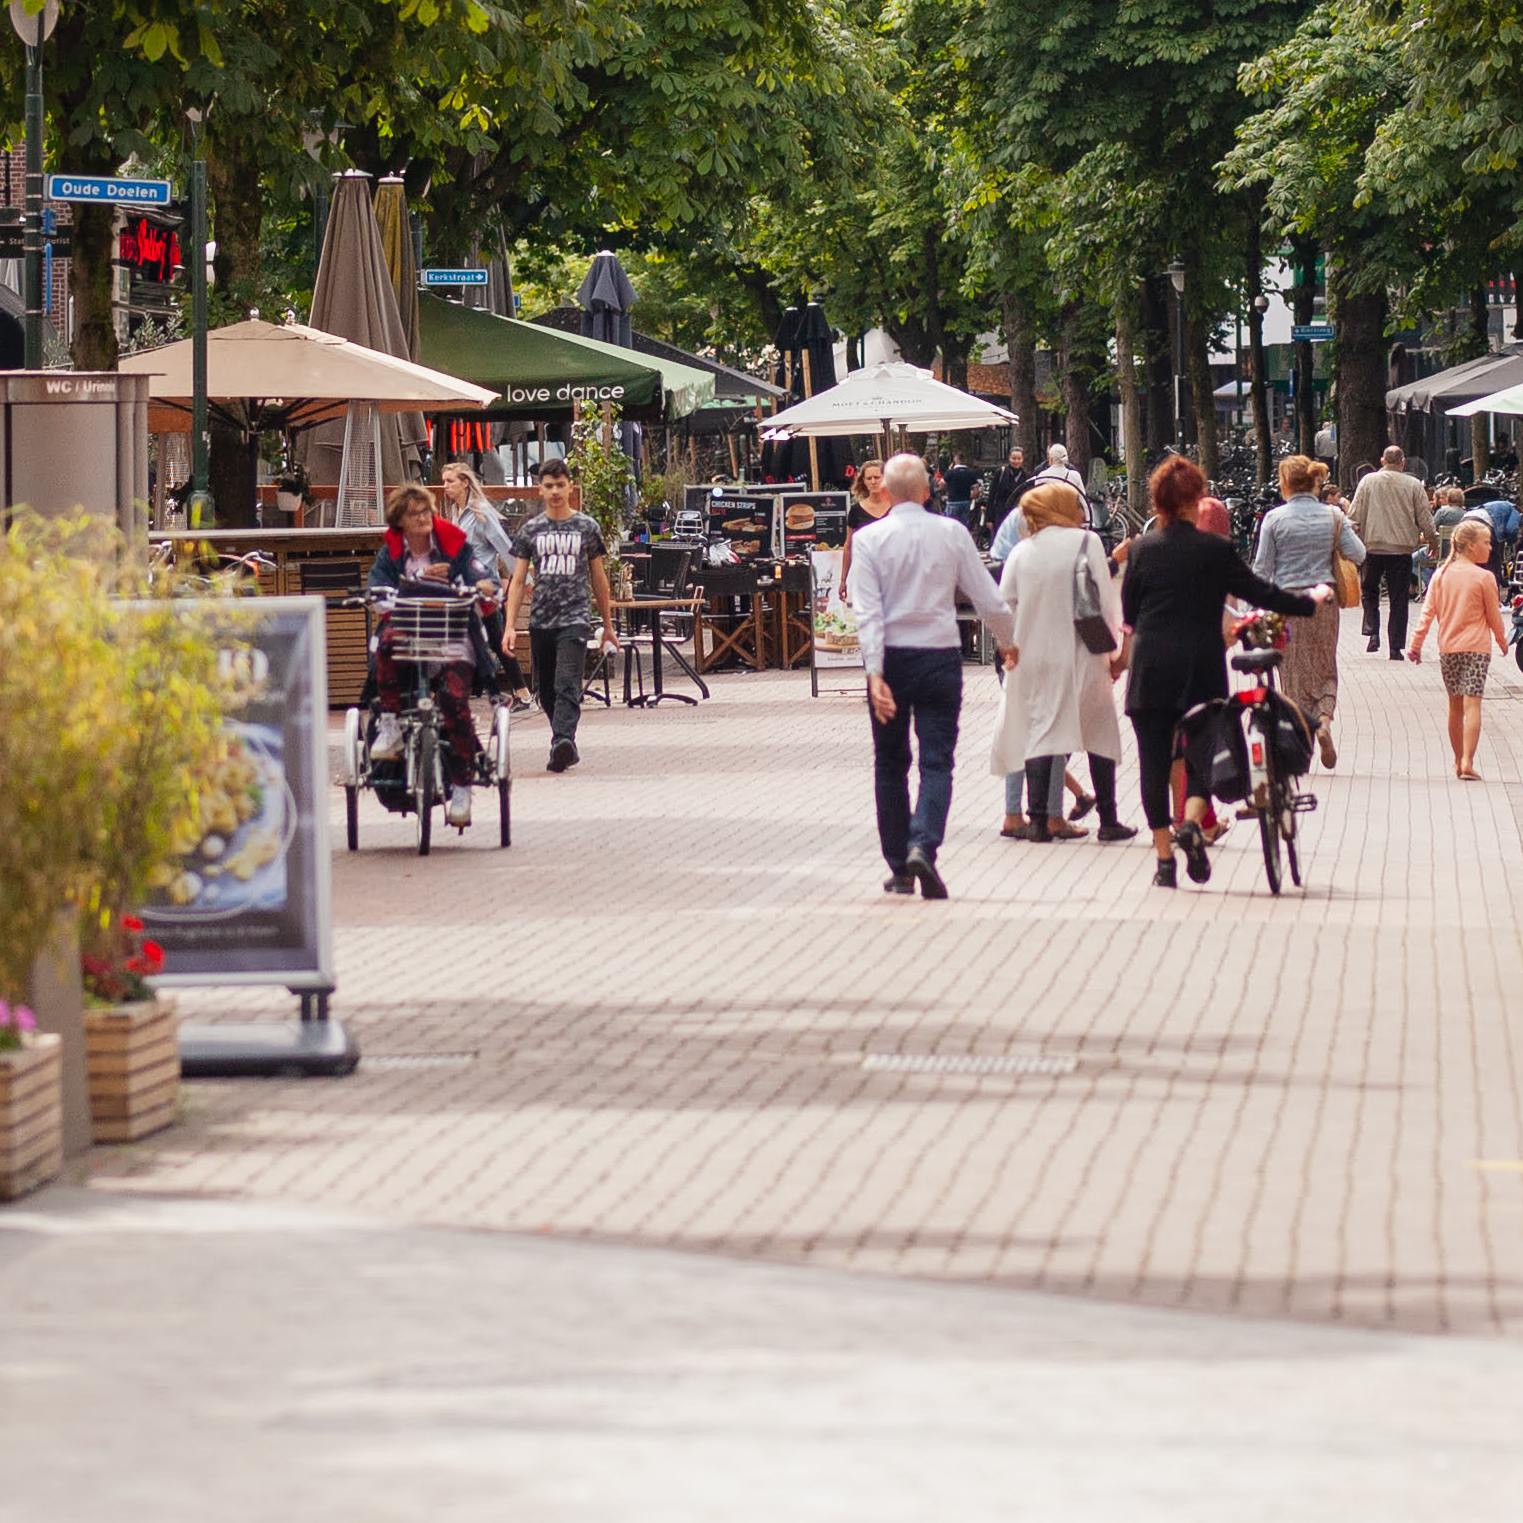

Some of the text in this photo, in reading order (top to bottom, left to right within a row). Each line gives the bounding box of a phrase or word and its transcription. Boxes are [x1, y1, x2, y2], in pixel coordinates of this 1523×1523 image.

[61, 181, 159, 199] Oude Doelen
[8, 237, 25, 246] Stat
[428, 273, 475, 282] Kerkstraat
[45, 380, 72, 394] WC
[507, 383, 625, 403] love dance
[711, 500, 757, 510] CHICKEN STRIPS
[536, 533, 582, 556] DOWN
[539, 554, 576, 576] LOAD
